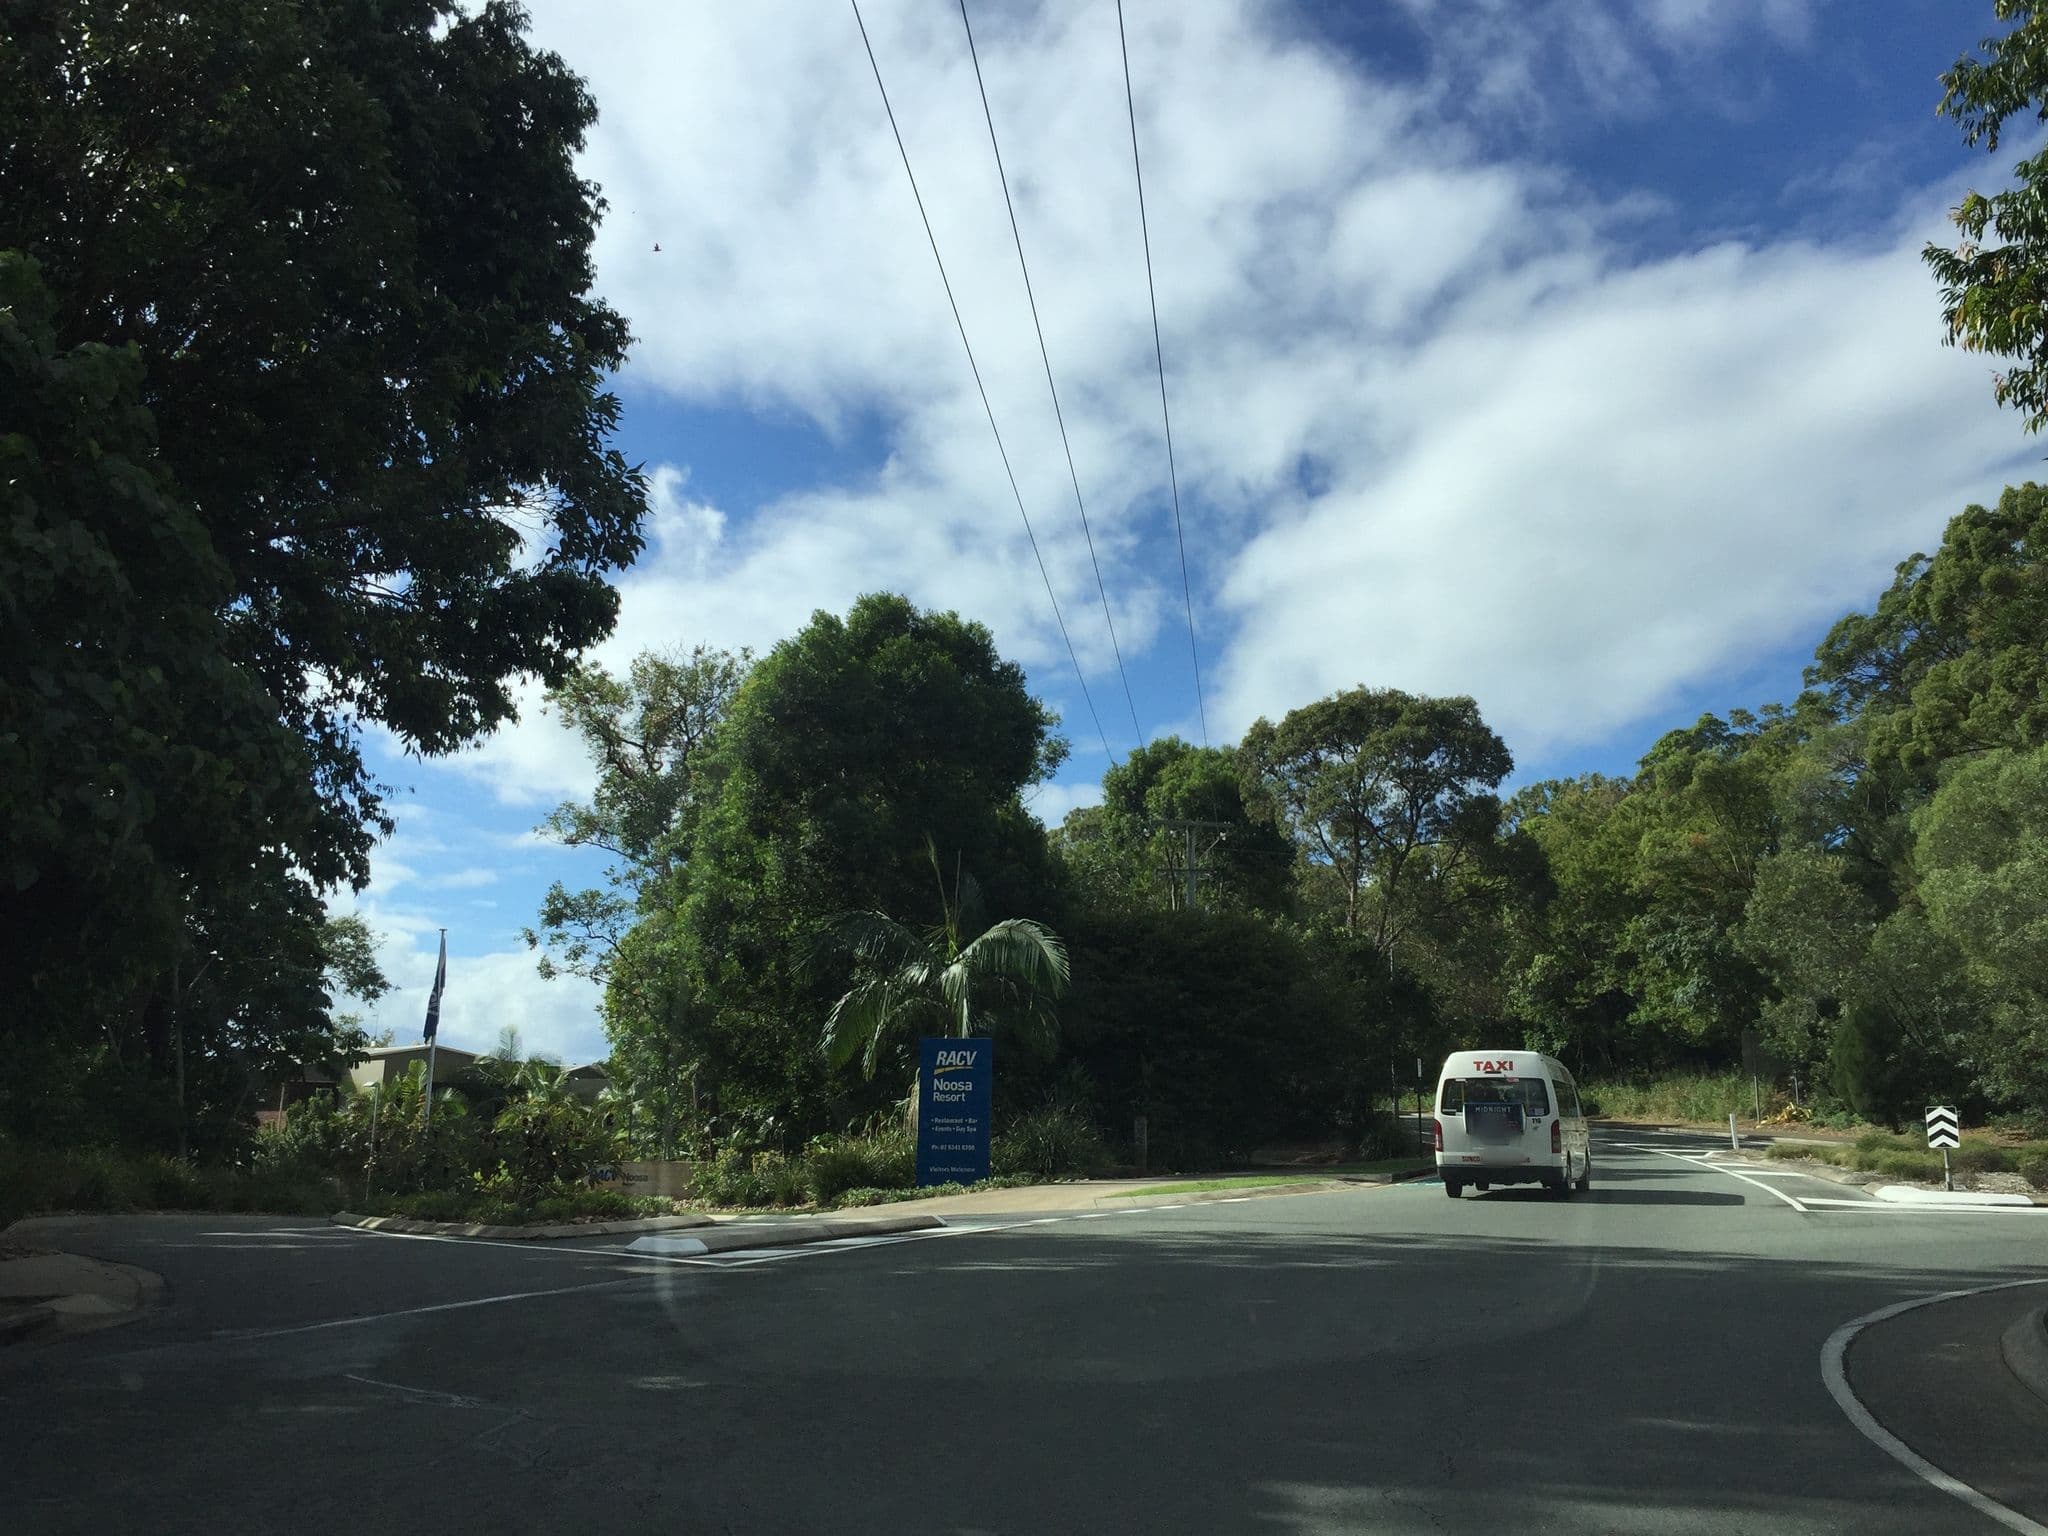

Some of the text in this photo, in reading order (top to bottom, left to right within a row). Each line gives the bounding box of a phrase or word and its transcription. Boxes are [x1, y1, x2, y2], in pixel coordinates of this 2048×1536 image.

[935, 1050, 978, 1066] RACV
[1473, 1060, 1514, 1071] TAXI
[933, 1078, 973, 1091] Noosa
[932, 1091, 966, 1102] Resort
